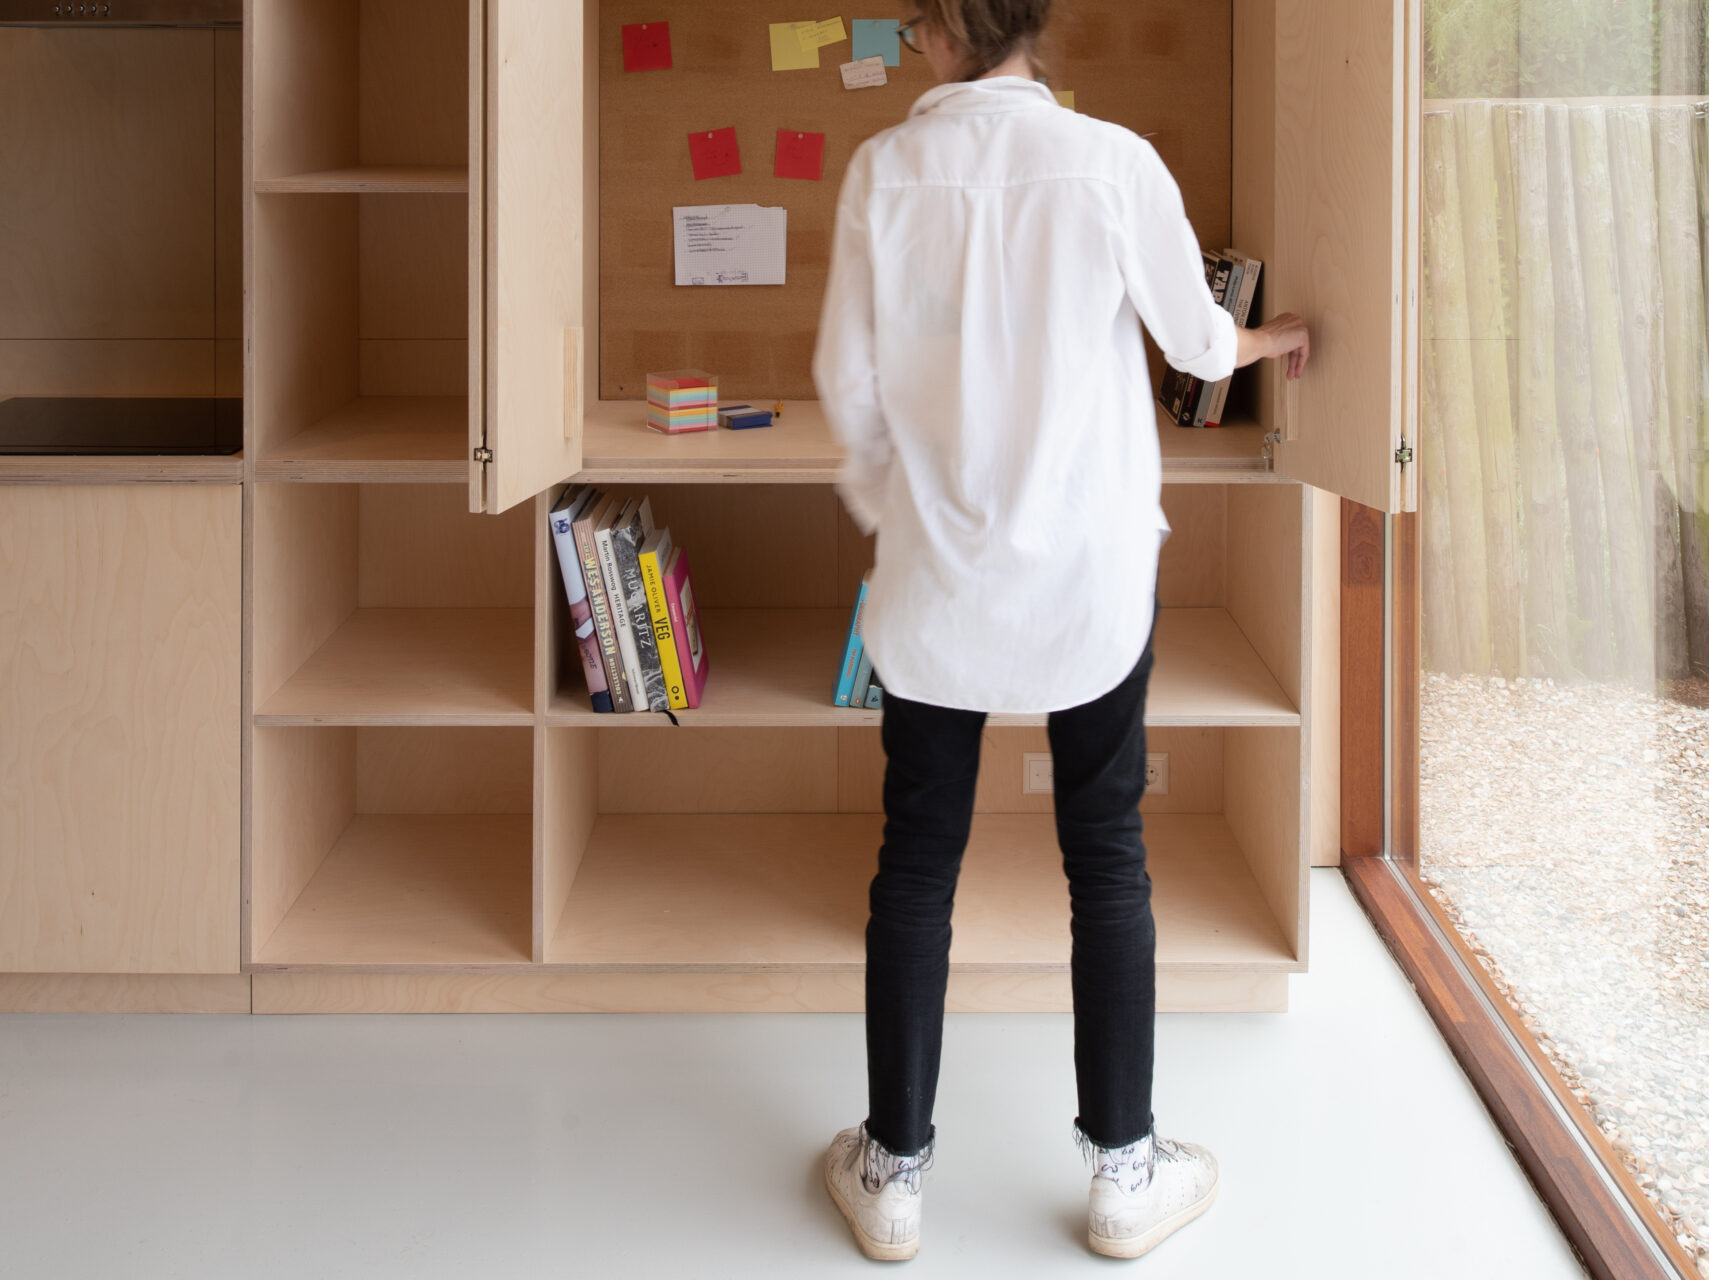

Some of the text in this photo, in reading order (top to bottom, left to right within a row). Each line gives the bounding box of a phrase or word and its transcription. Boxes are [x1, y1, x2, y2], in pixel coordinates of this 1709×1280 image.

[584, 558, 600, 589] WES
[602, 540, 627, 628] Martin Rosswog HERITAGE
[646, 564, 671, 641] JAMIE OLIVER VEG
[590, 589, 616, 657] ANDERSON
[609, 657, 622, 695] COLLECTION
